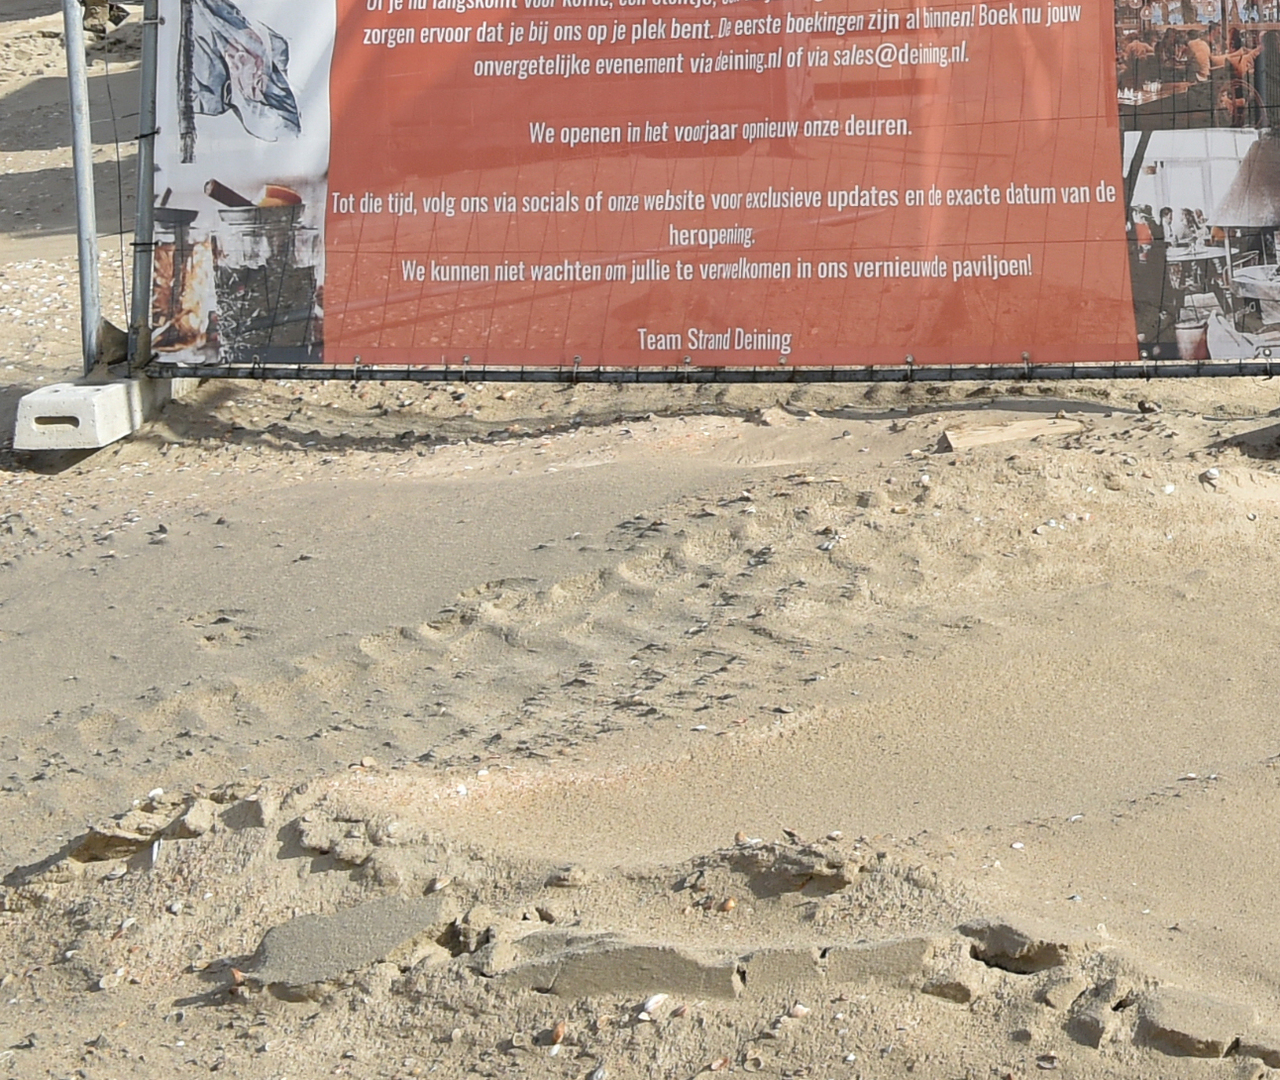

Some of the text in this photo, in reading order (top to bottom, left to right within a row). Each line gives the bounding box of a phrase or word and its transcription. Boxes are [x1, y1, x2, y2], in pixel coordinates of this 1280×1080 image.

[474, 41, 969, 79] onvergetelijke evenement via deining.nl of via sales@deining.nl.
[529, 115, 912, 147] We openen in het voorjaar opnieuw onze deuren.
[669, 224, 755, 248] heropening.
[638, 328, 792, 354] Team Strand Deining
